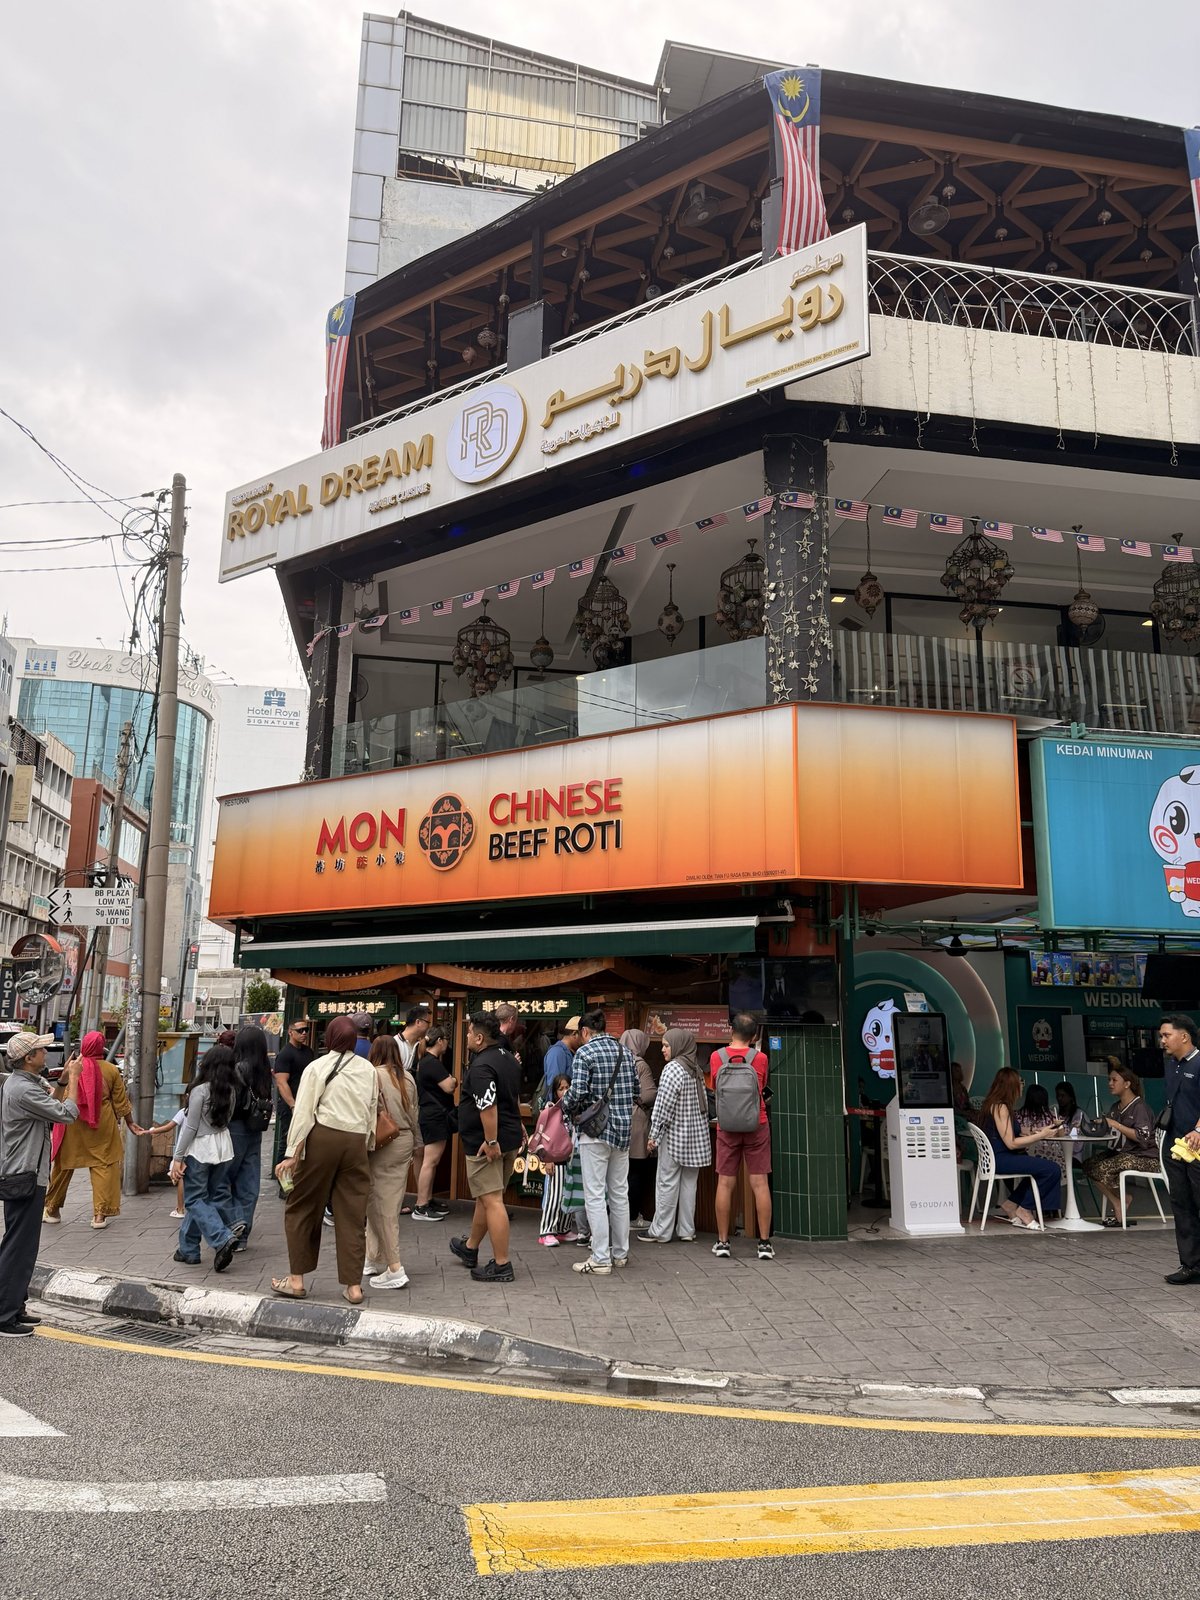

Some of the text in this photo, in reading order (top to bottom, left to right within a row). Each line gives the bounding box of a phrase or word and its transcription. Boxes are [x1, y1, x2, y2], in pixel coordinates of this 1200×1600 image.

[226, 433, 434, 541] ROYAL DREAM
[246, 718, 300, 726] SIGNATURE
[247, 707, 301, 718] Hotel Royal
[1056, 744, 1153, 760] KEDAI MINUMAN
[224, 797, 250, 807] RESTORAN
[488, 777, 623, 827] CHINESE
[170, 822, 192, 830] TANG
[315, 807, 408, 857] MON
[488, 827, 549, 862] BEEF
[554, 819, 622, 855] ROTI
[1, 970, 13, 1018] HOTEL
